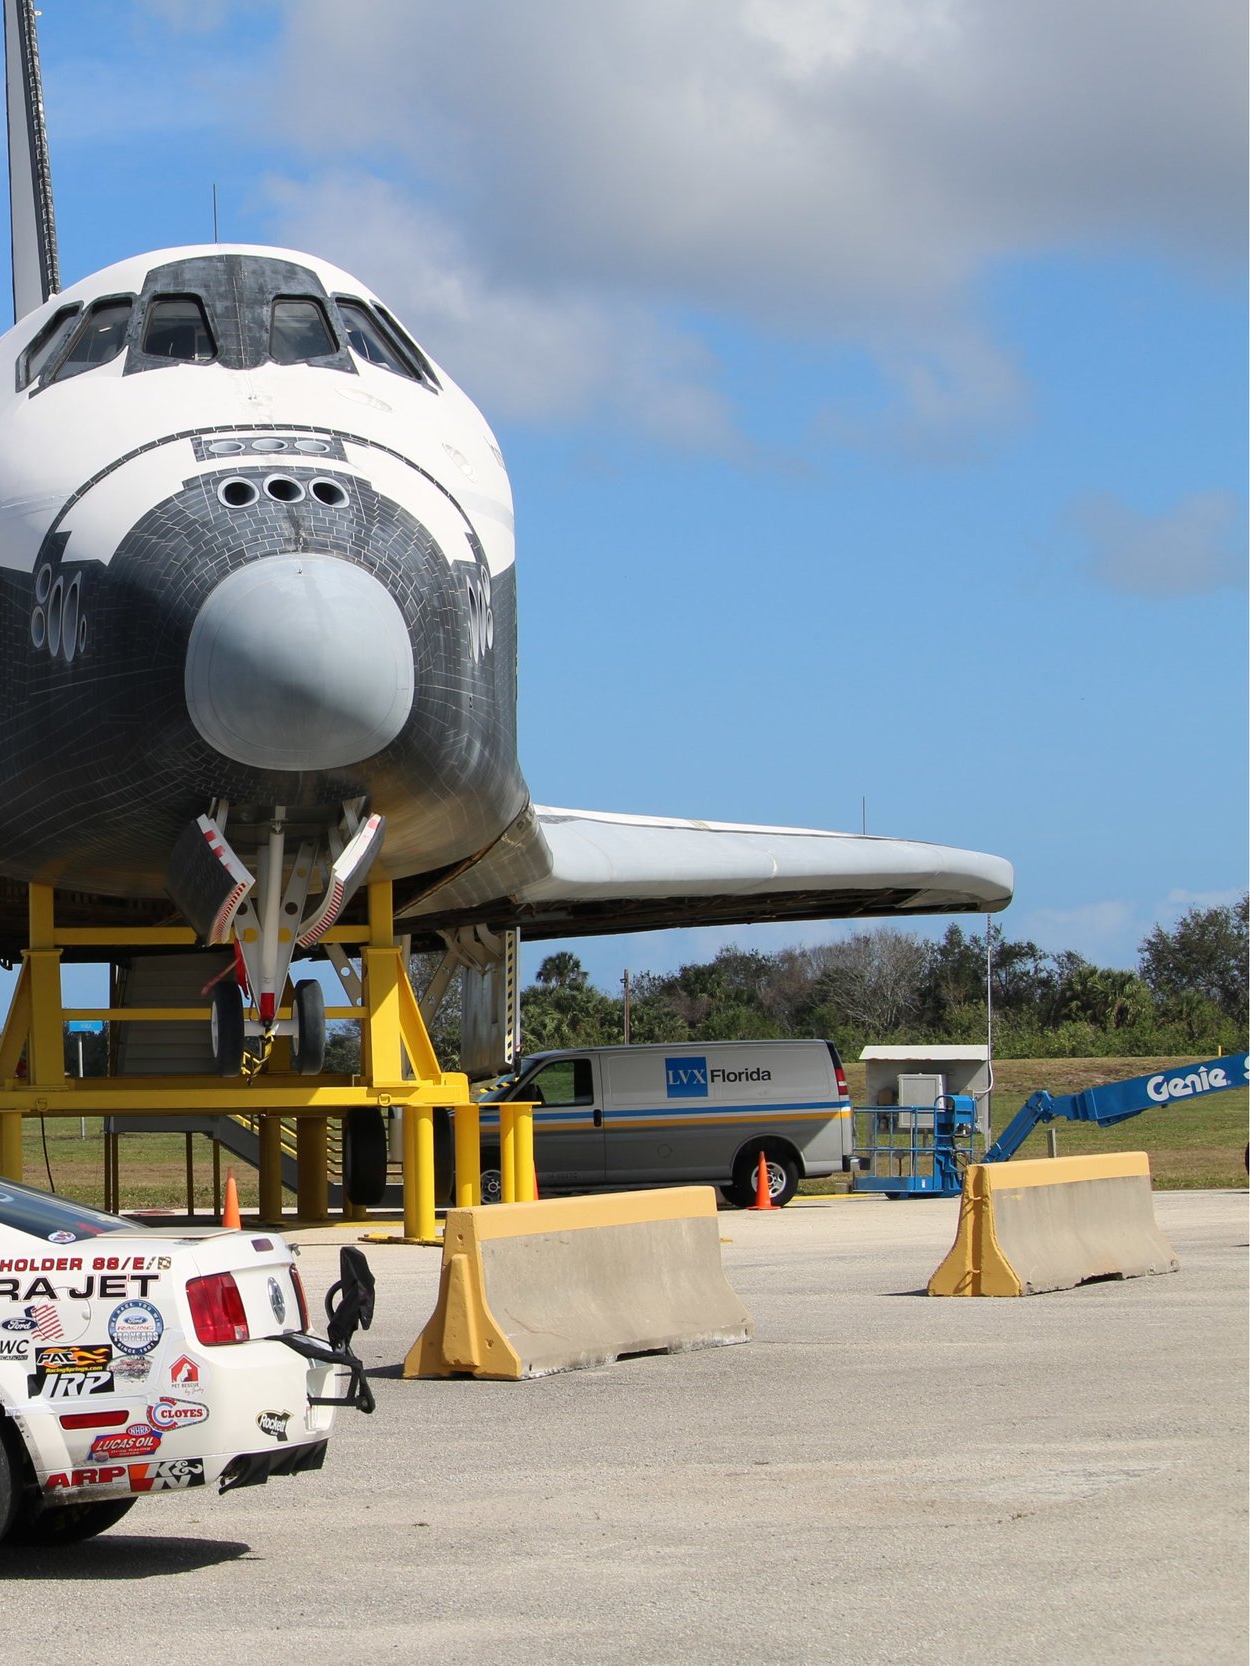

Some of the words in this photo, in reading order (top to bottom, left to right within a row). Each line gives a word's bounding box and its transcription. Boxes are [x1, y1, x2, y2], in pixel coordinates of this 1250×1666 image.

[668, 1069, 707, 1085] LVX
[710, 1067, 771, 1083] Florida
[1147, 1066, 1227, 1101] Genie
[0, 1258, 83, 1272] HOLDER
[67, 1274, 161, 1299] JET
[130, 1331, 159, 1341] YEARS
[37, 1351, 78, 1365] PAC
[160, 1409, 203, 1419] CLOYES
[129, 1426, 150, 1435] NHRA
[97, 1438, 135, 1450] LUCAS
[136, 1436, 154, 1447] OIL
[45, 1467, 126, 1488] ARP
